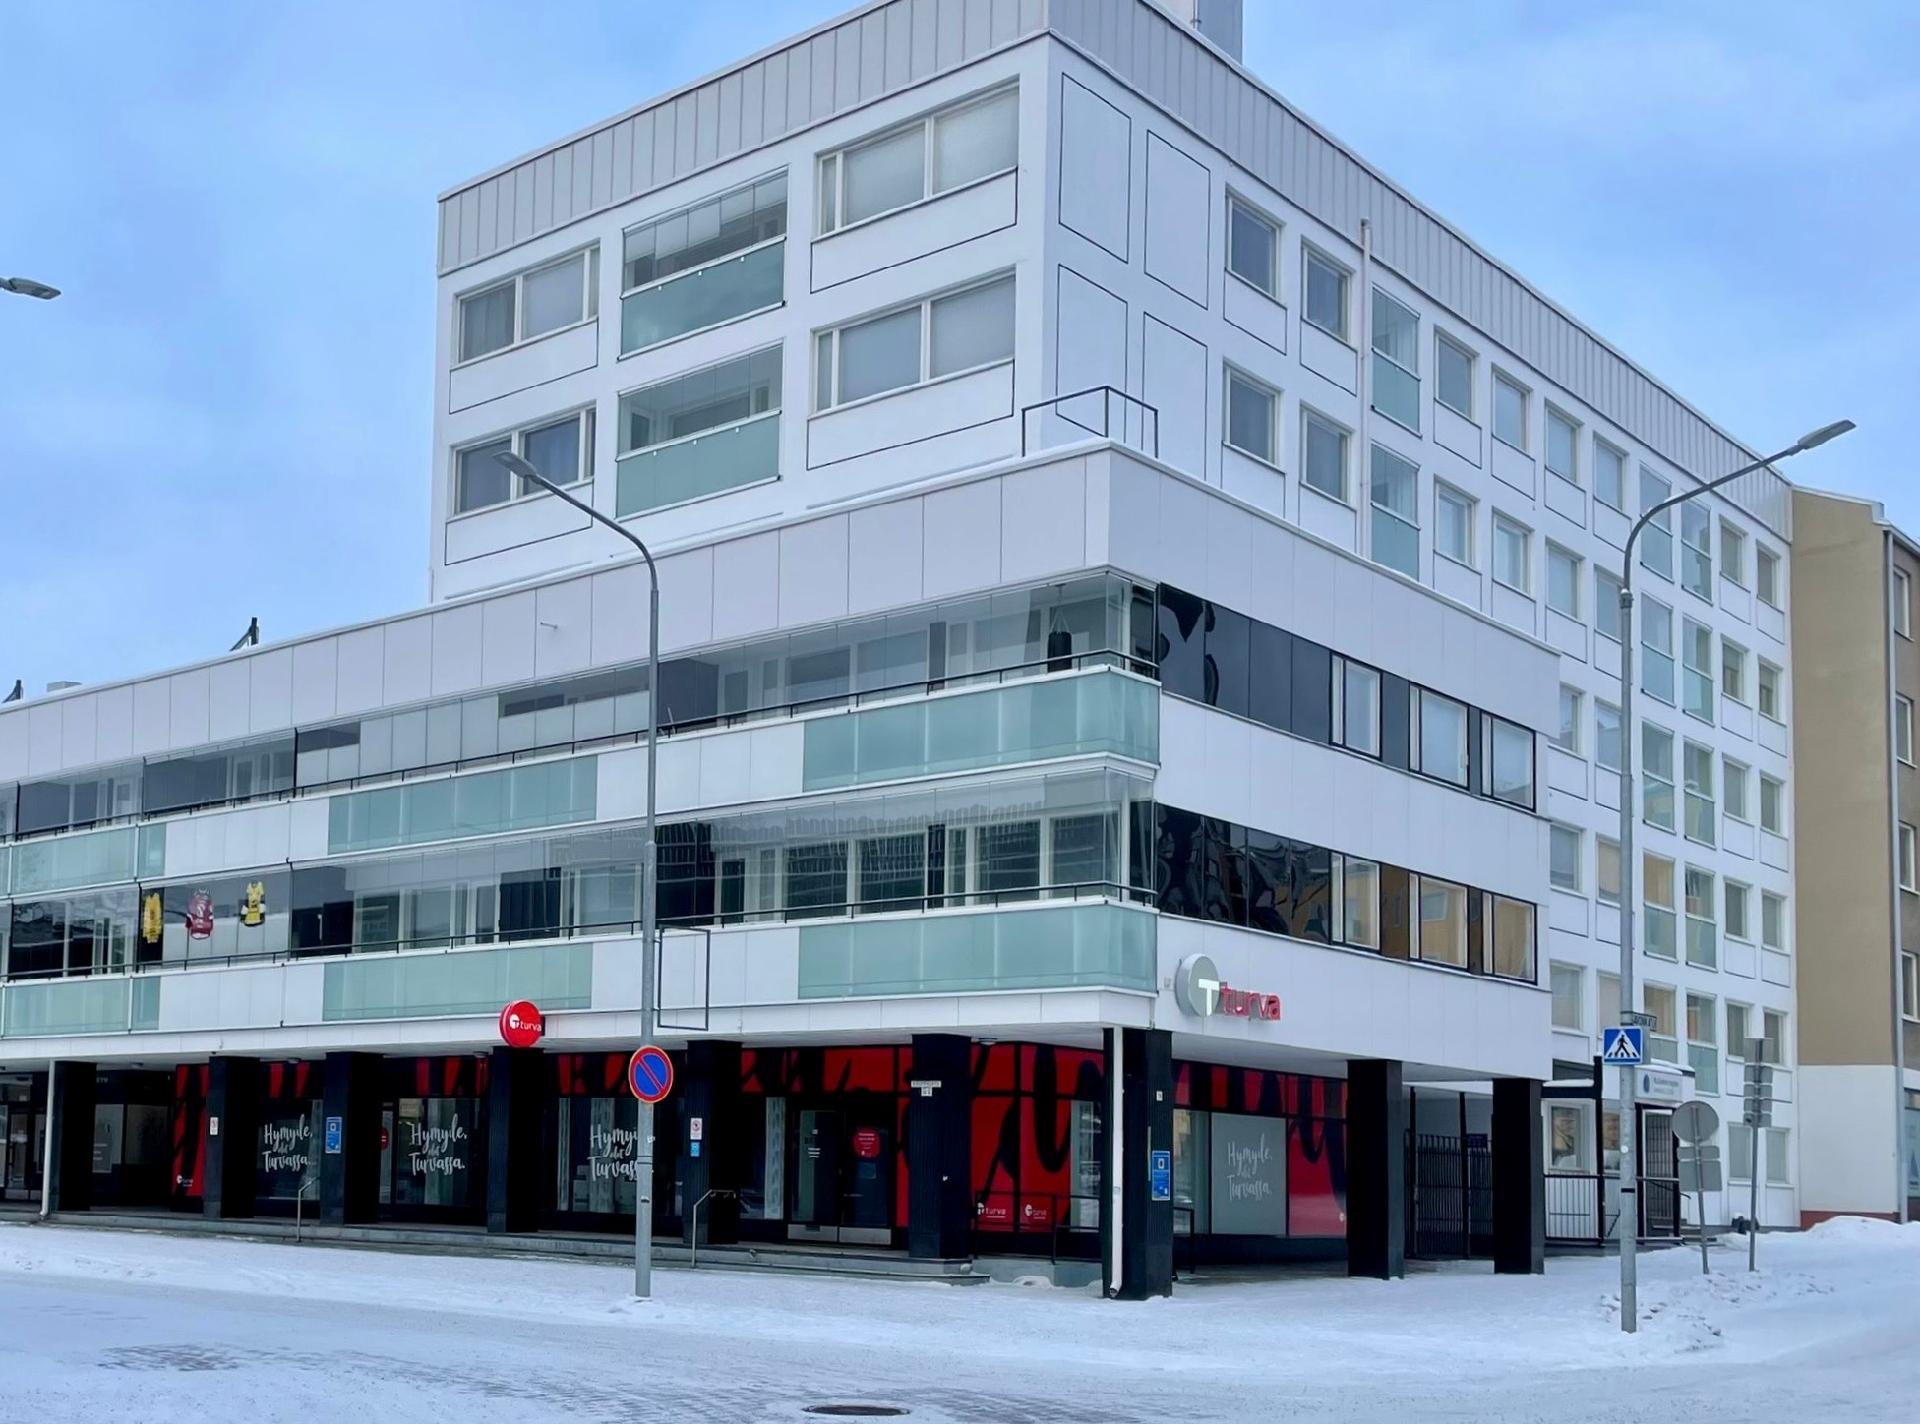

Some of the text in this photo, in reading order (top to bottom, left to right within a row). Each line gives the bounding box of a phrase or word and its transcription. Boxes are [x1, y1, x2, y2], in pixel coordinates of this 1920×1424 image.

[1221, 985, 1281, 1021] turva
[520, 1020, 542, 1032] turva
[590, 1123, 638, 1157] Hymyi
